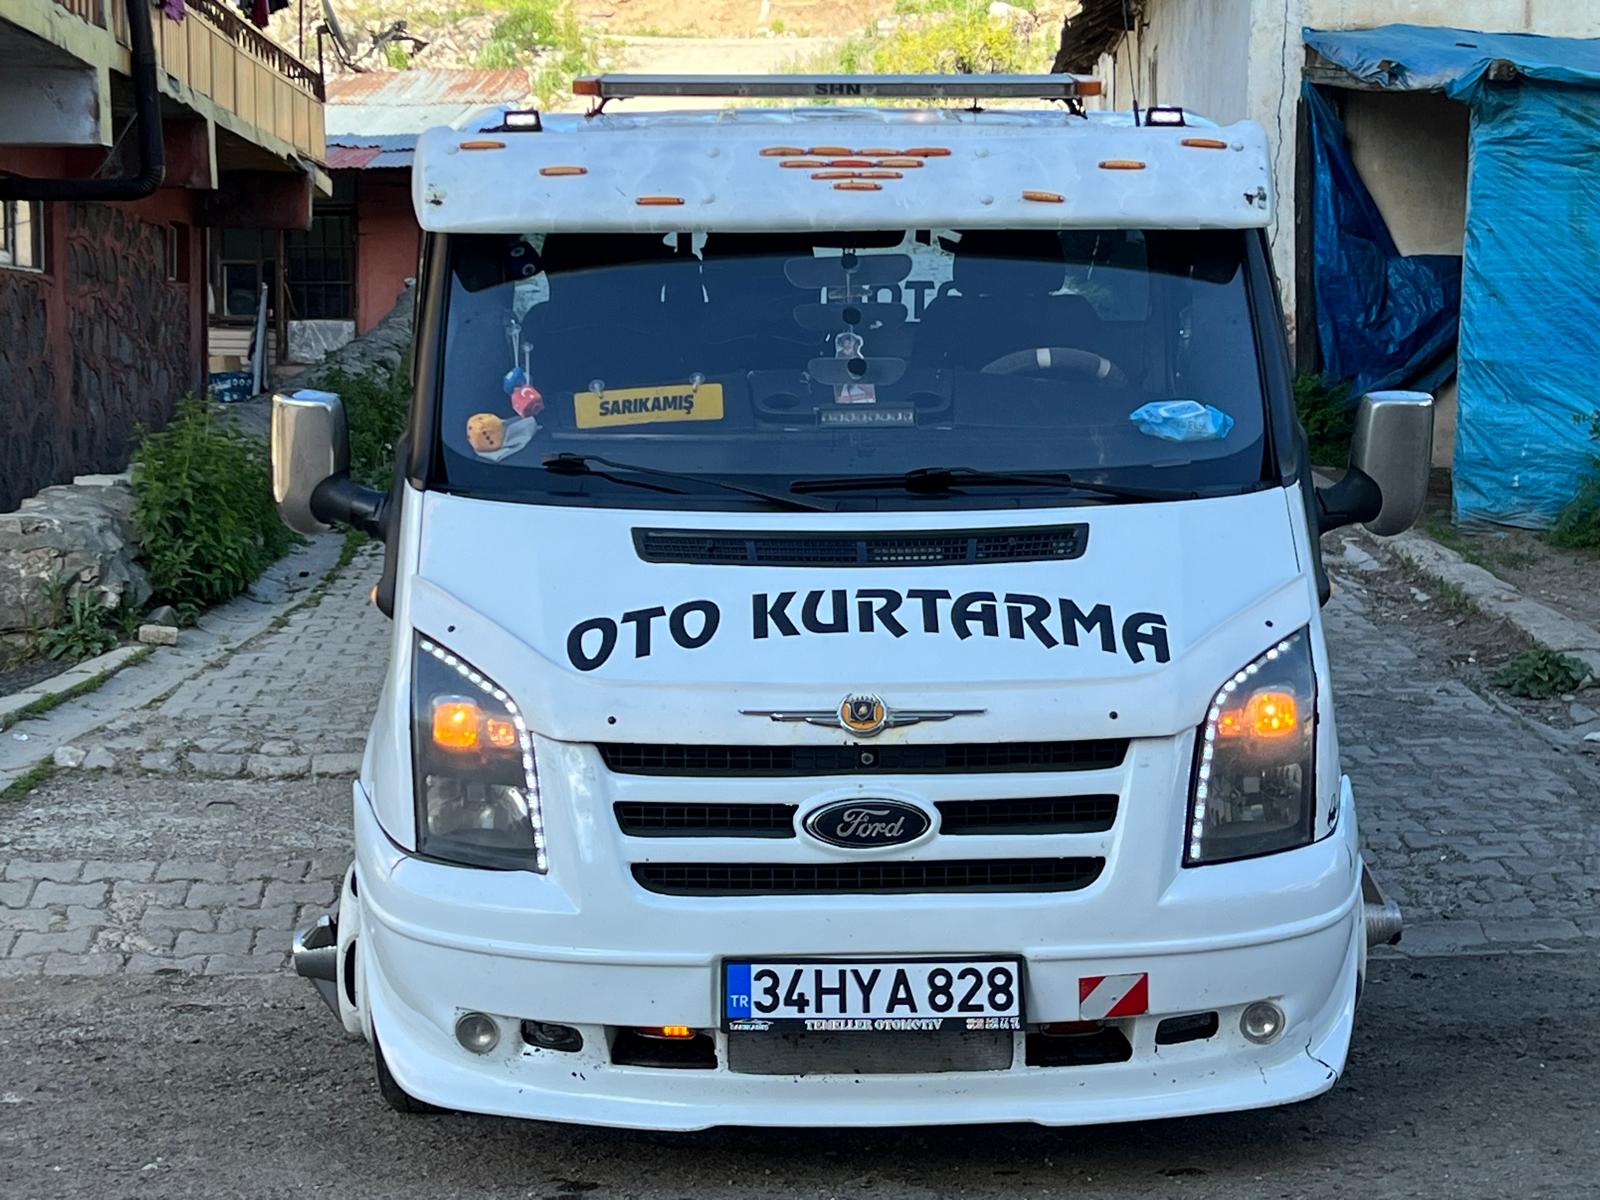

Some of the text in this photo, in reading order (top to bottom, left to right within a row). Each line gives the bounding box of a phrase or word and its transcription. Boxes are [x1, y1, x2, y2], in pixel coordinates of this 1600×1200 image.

[816, 84, 860, 95] SHN
[600, 395, 694, 416] SARIKAMIŞ
[566, 588, 1172, 672] OTO KURTARMA
[836, 808, 905, 837] Ford
[730, 994, 749, 1008] TR
[805, 1019, 873, 1031] TEMELLER
